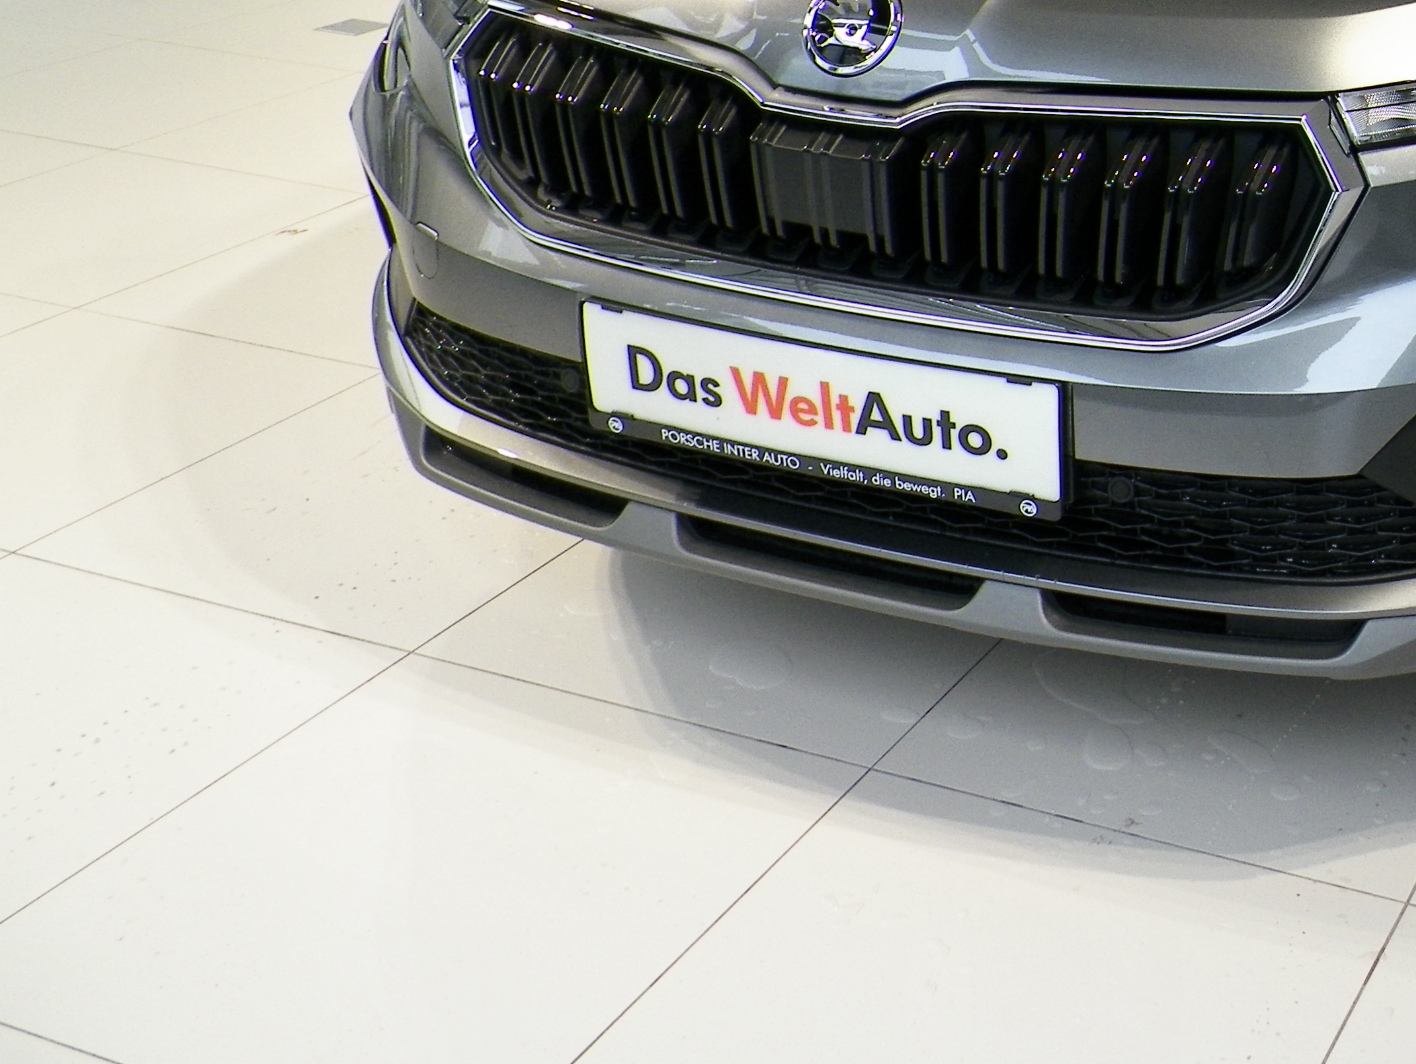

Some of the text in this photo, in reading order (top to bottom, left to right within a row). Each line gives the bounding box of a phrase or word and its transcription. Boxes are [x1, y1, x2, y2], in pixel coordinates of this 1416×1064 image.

[626, 344, 1009, 461] Das WeltAuto.
[661, 428, 721, 453] PORSCHE
[723, 442, 760, 462] INTER
[762, 451, 801, 471] AUTO
[820, 462, 868, 485] Vielfalt,
[871, 472, 892, 487] die
[894, 476, 946, 499] bewegt.
[953, 487, 977, 504] PIA
